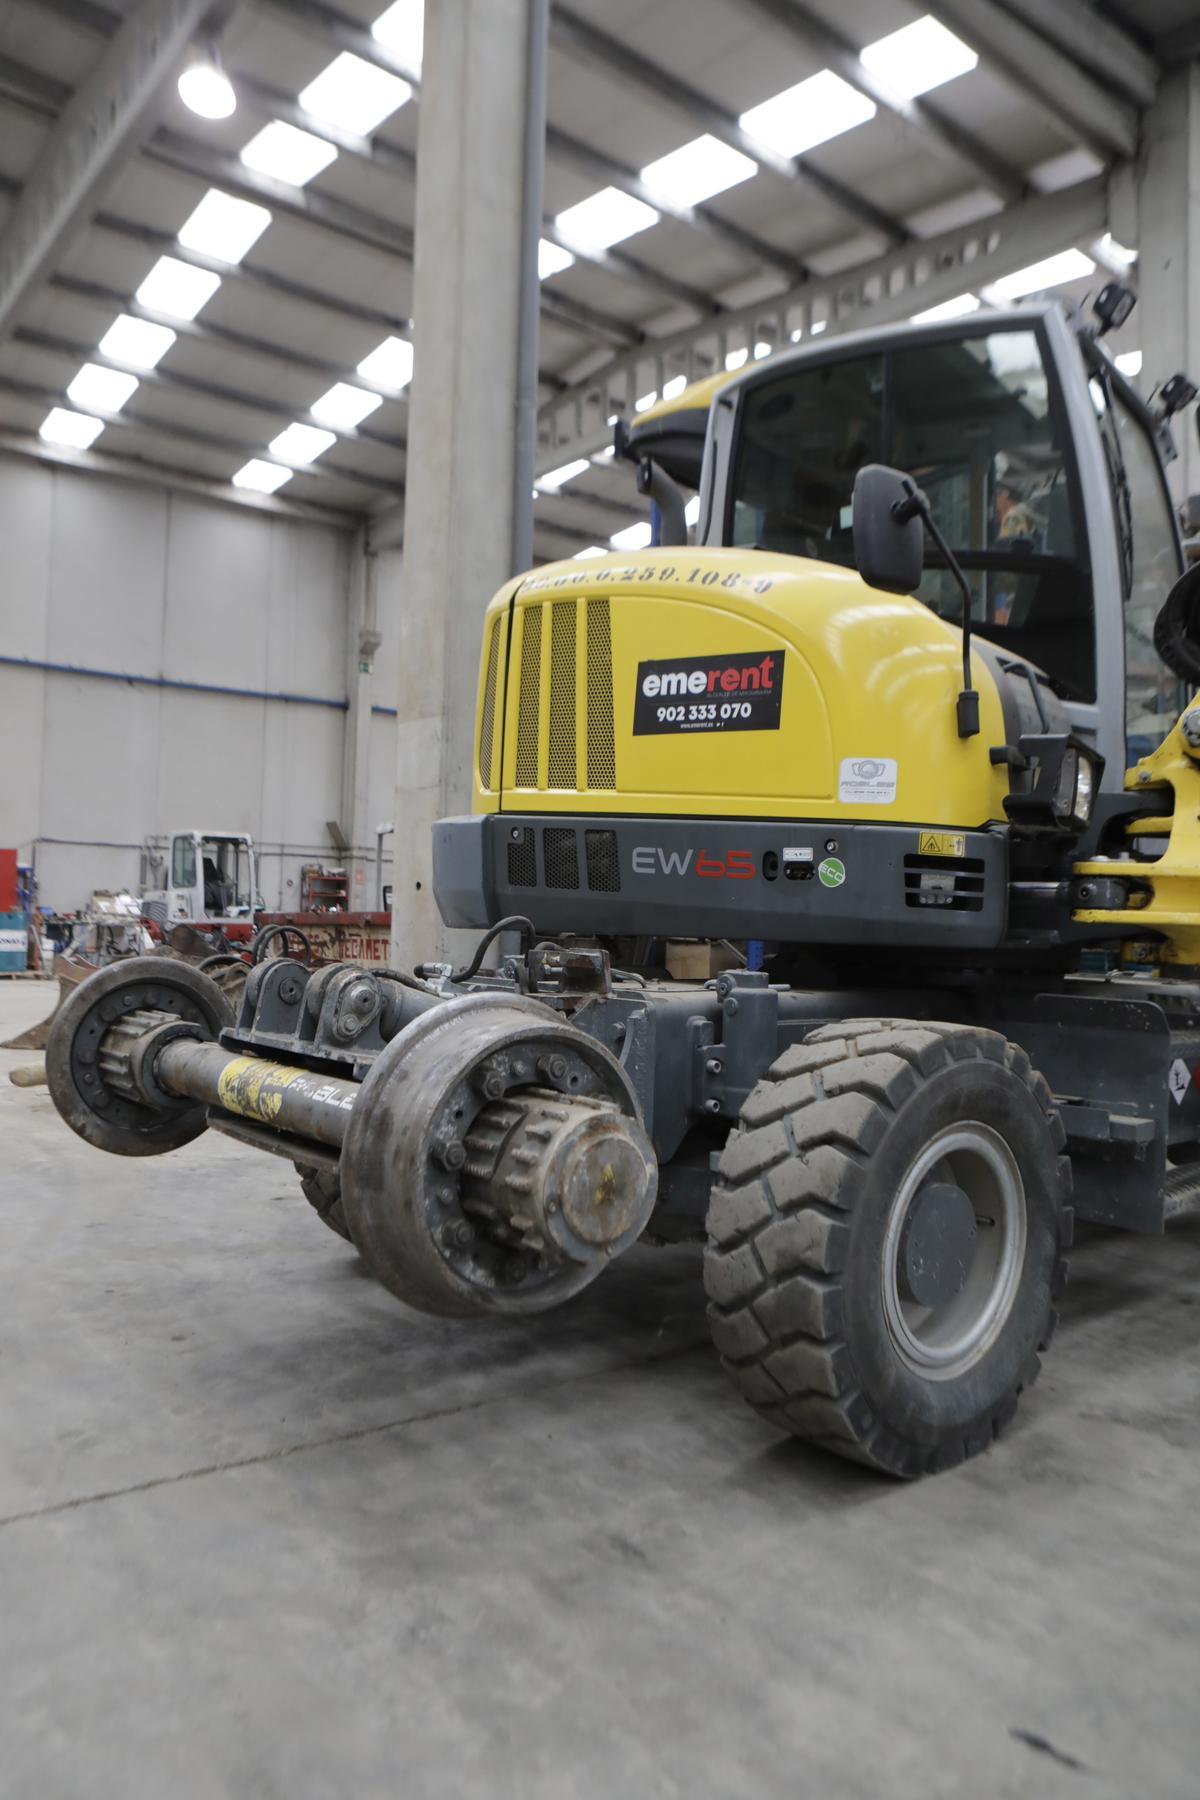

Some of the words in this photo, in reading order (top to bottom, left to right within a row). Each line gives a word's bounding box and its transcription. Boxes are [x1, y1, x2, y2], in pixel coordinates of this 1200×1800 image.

[642, 655, 775, 698] emerent
[656, 706, 686, 722] 902
[688, 704, 717, 721] 333
[720, 702, 752, 719] 070
[631, 846, 757, 880] EW65
[819, 862, 846, 884] ECO
